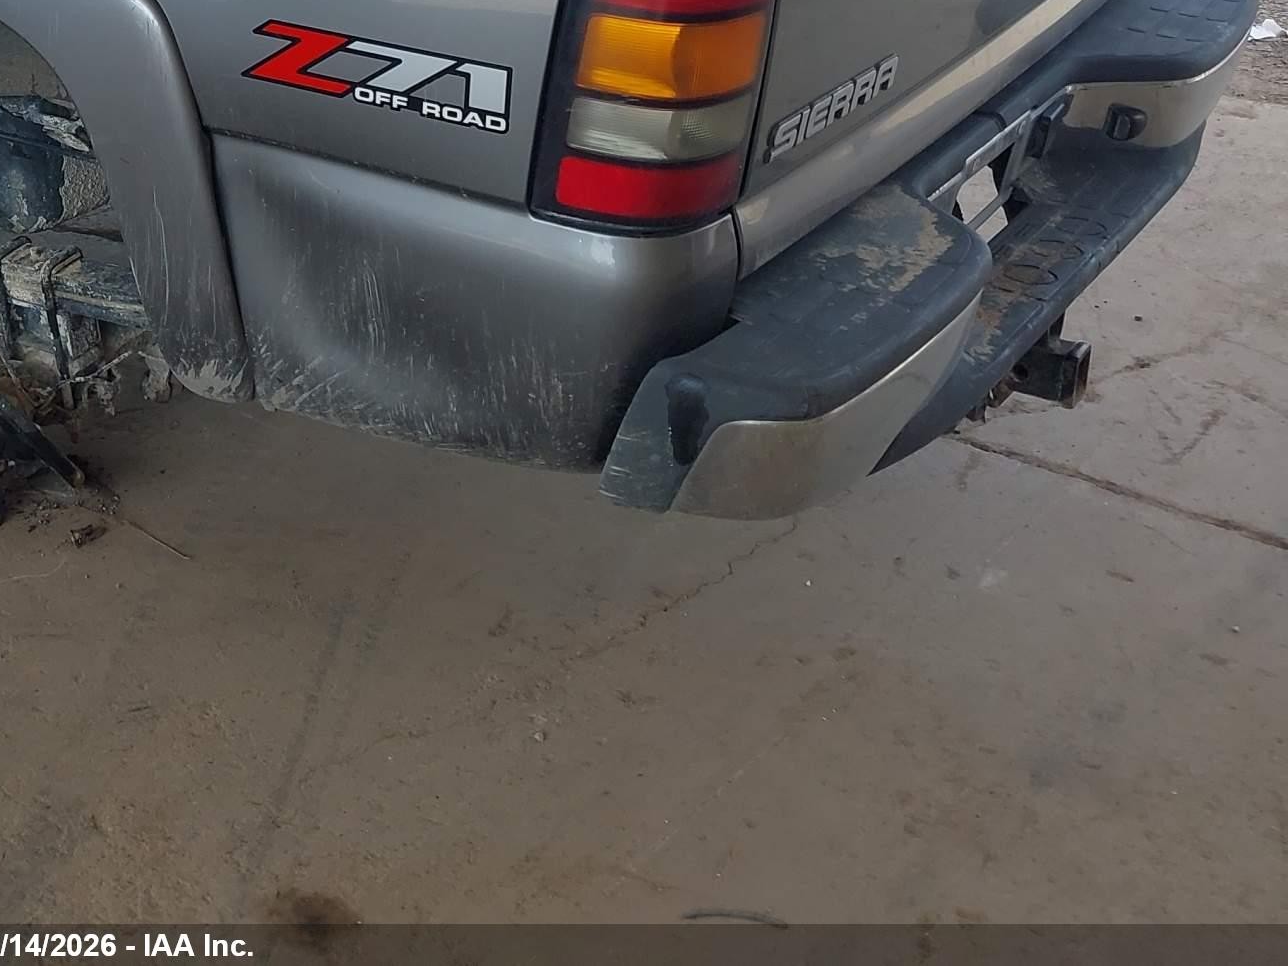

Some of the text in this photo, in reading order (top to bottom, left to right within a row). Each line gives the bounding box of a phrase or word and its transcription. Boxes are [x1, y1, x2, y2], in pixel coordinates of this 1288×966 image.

[242, 19, 511, 115] Z71
[353, 86, 507, 132] OFF ROAD
[765, 53, 899, 164] SIERRA
